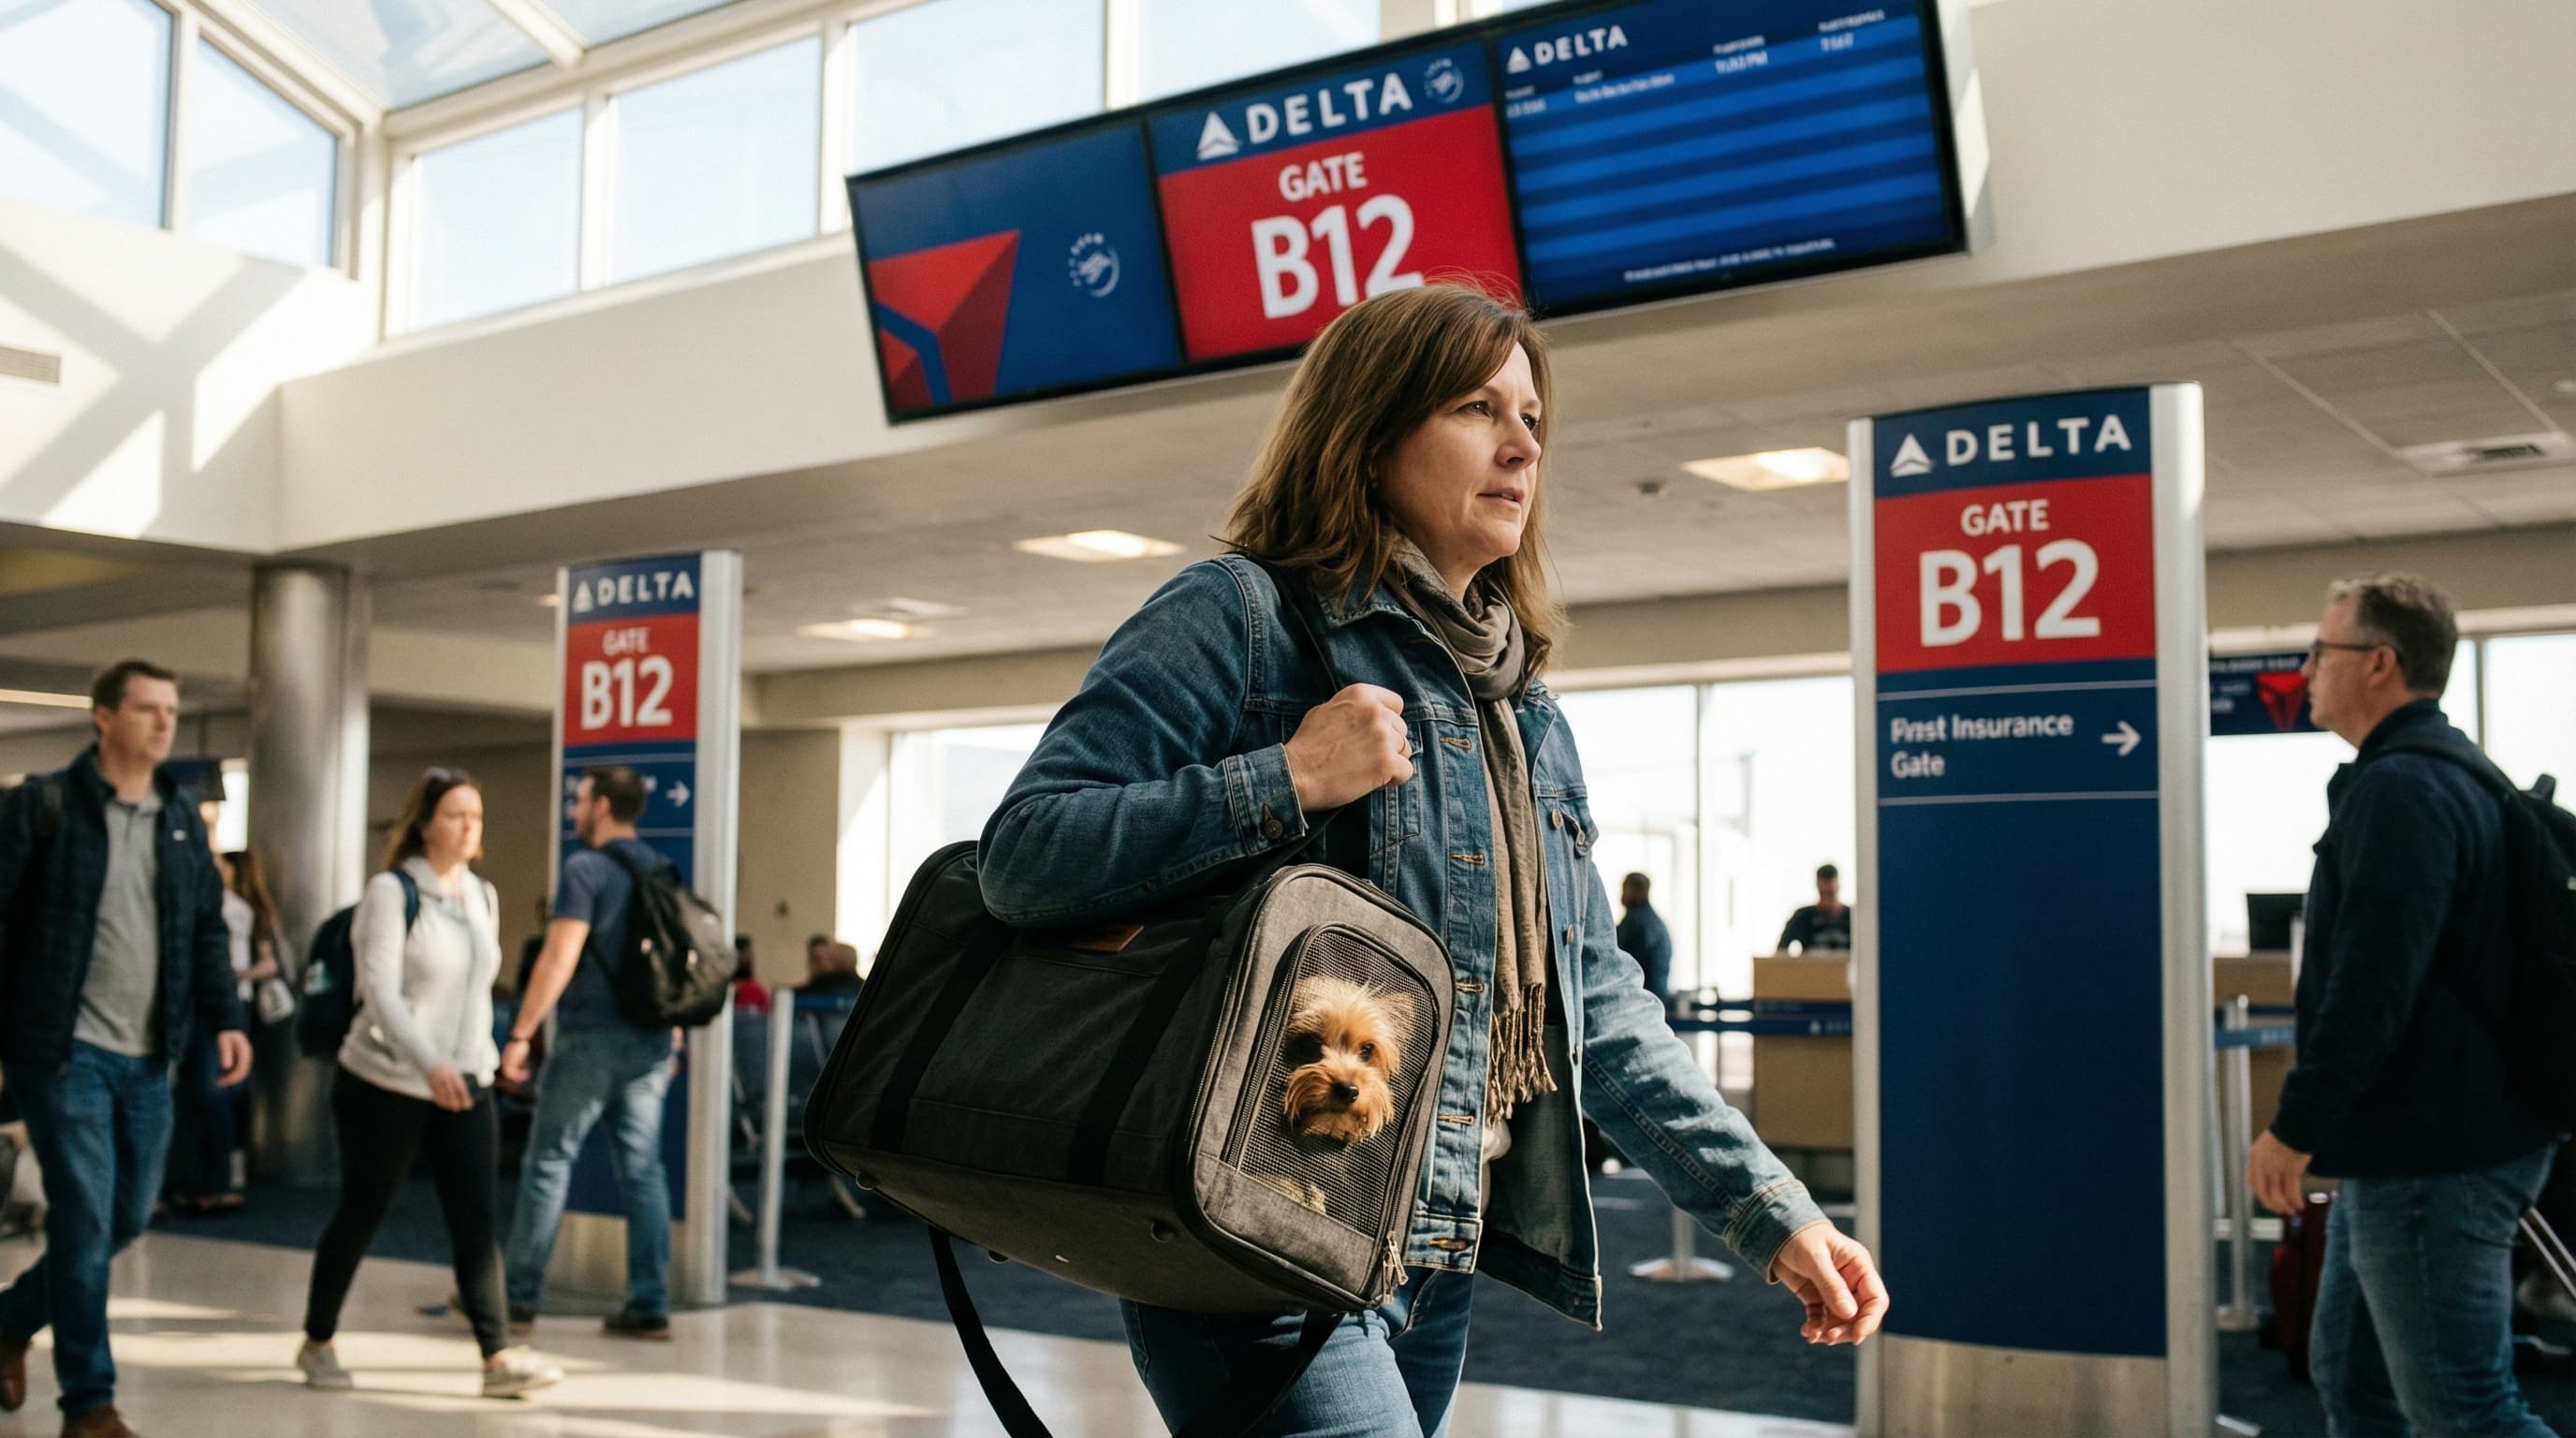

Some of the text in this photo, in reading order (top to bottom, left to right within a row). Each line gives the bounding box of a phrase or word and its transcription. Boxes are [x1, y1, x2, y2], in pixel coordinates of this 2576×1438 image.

[1535, 24, 1628, 66] DELTA
[1246, 73, 1413, 144] DELTA
[1279, 153, 1368, 202] GATE
[1251, 194, 1424, 319] B12
[1946, 414, 2131, 466] DELTA
[1961, 499, 2049, 536] GATE
[597, 571, 694, 607] DELTA
[1919, 538, 2100, 647] B12
[604, 628, 648, 655] GATE
[581, 655, 673, 729] B12
[1952, 714, 2074, 740] Insurance
[1891, 751, 1945, 779] Gate
